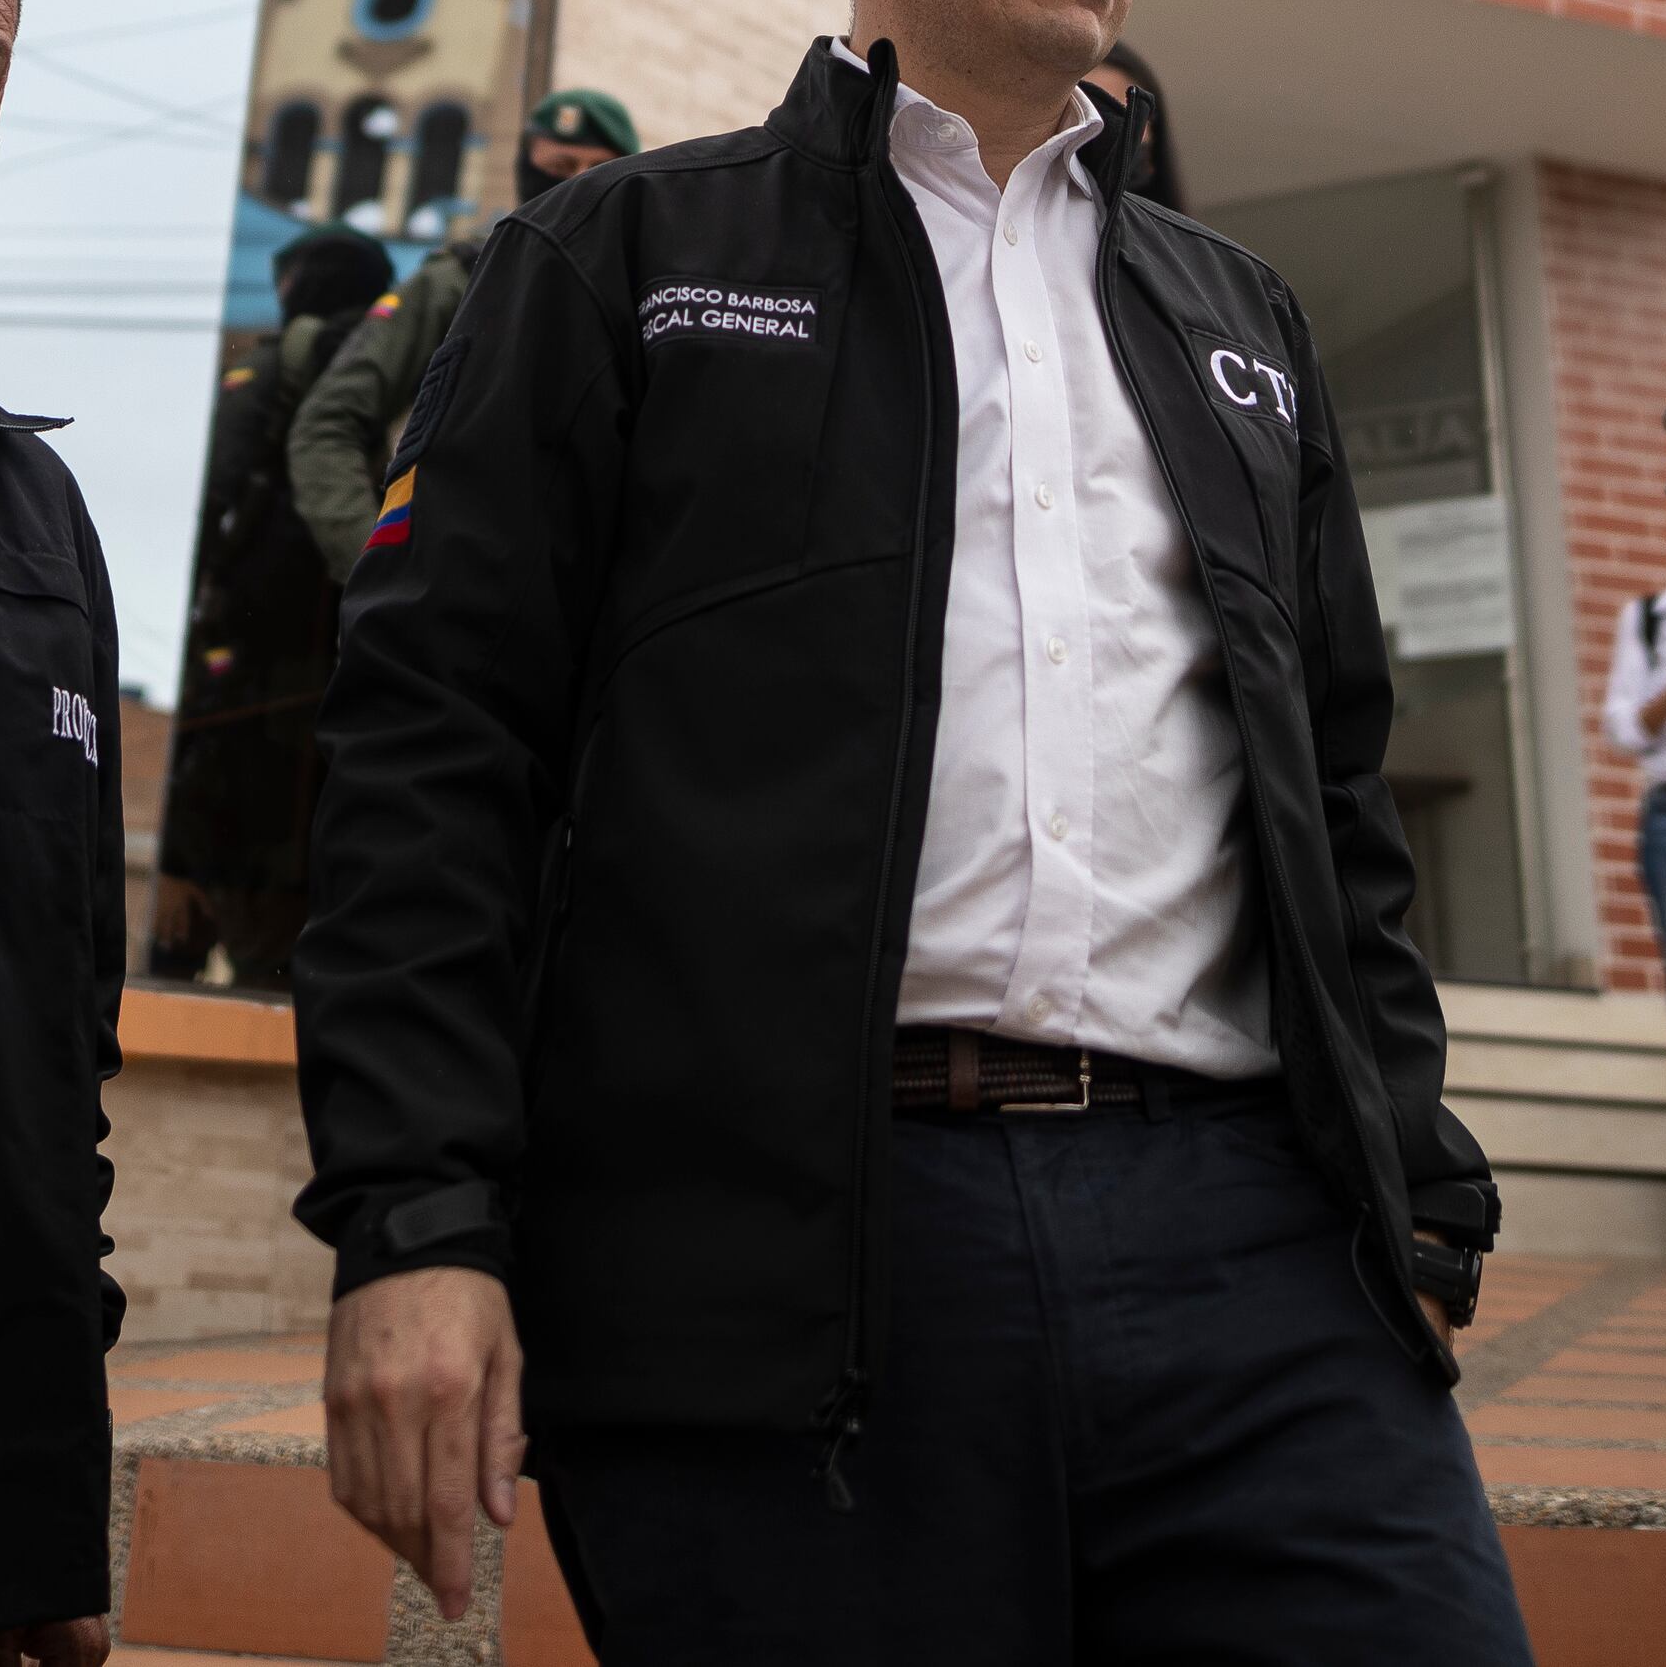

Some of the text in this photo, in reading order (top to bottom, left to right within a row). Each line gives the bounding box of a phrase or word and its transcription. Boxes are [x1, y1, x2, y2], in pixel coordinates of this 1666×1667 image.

[638, 286, 816, 318] RANCISCO BARBOSA
[701, 309, 810, 339] GENERAL
